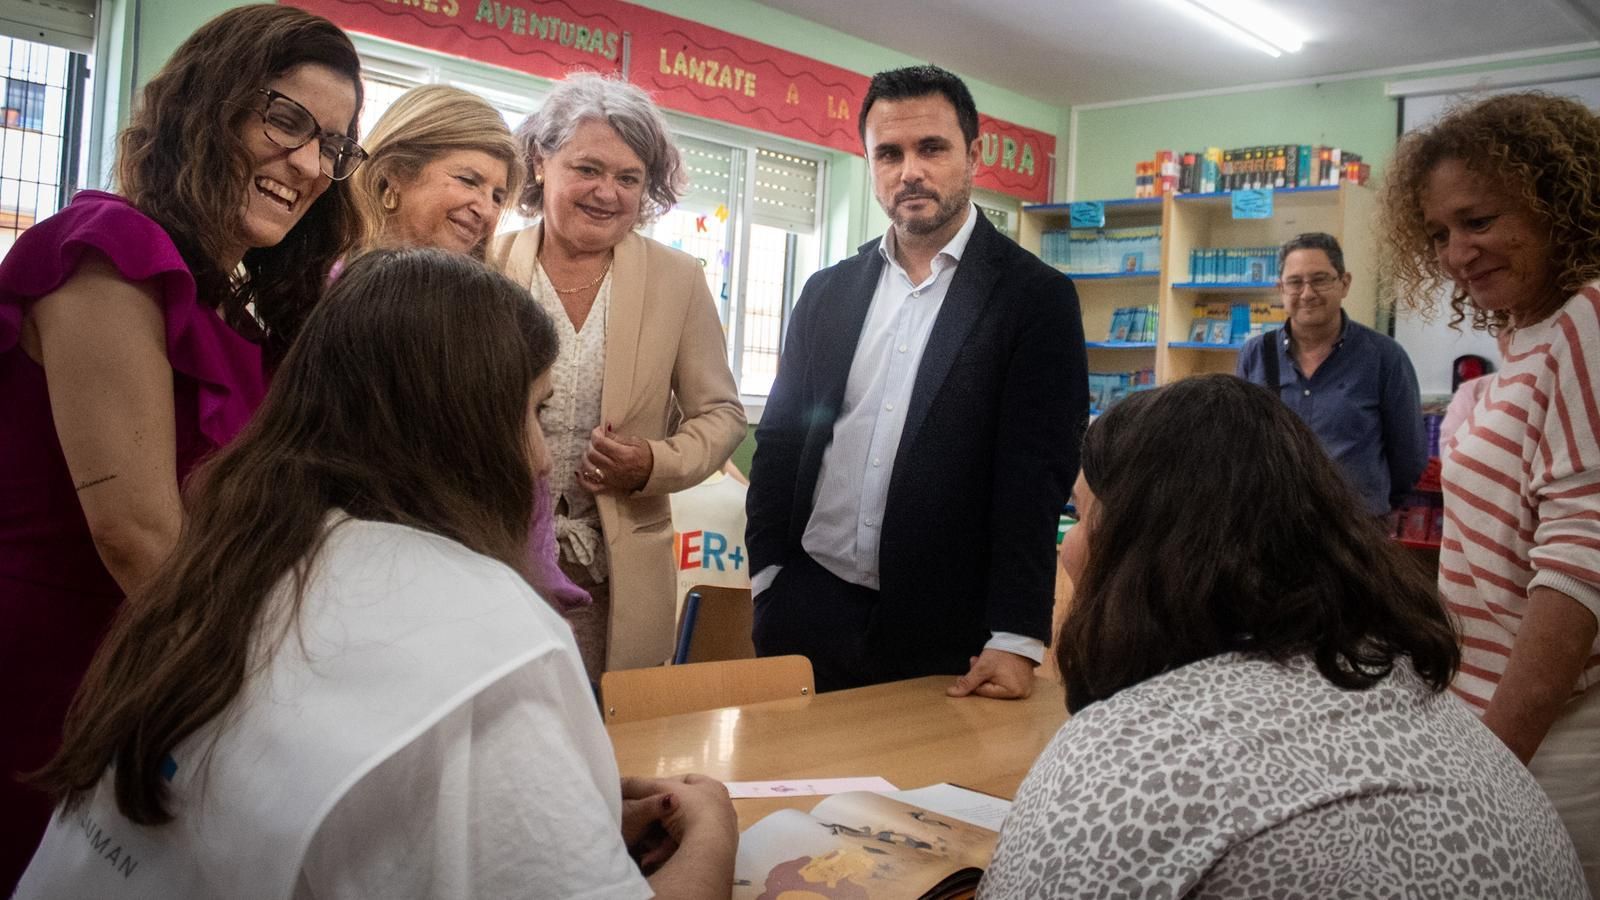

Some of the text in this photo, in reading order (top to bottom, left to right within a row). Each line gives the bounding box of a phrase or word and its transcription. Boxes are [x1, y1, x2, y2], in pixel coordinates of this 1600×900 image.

[475, 0, 619, 61] AVENTURAS
[786, 82, 800, 105] A
[827, 95, 850, 120] LA
[981, 132, 1035, 177] URA
[696, 216, 707, 233] K
[80, 817, 138, 879] UMAN
